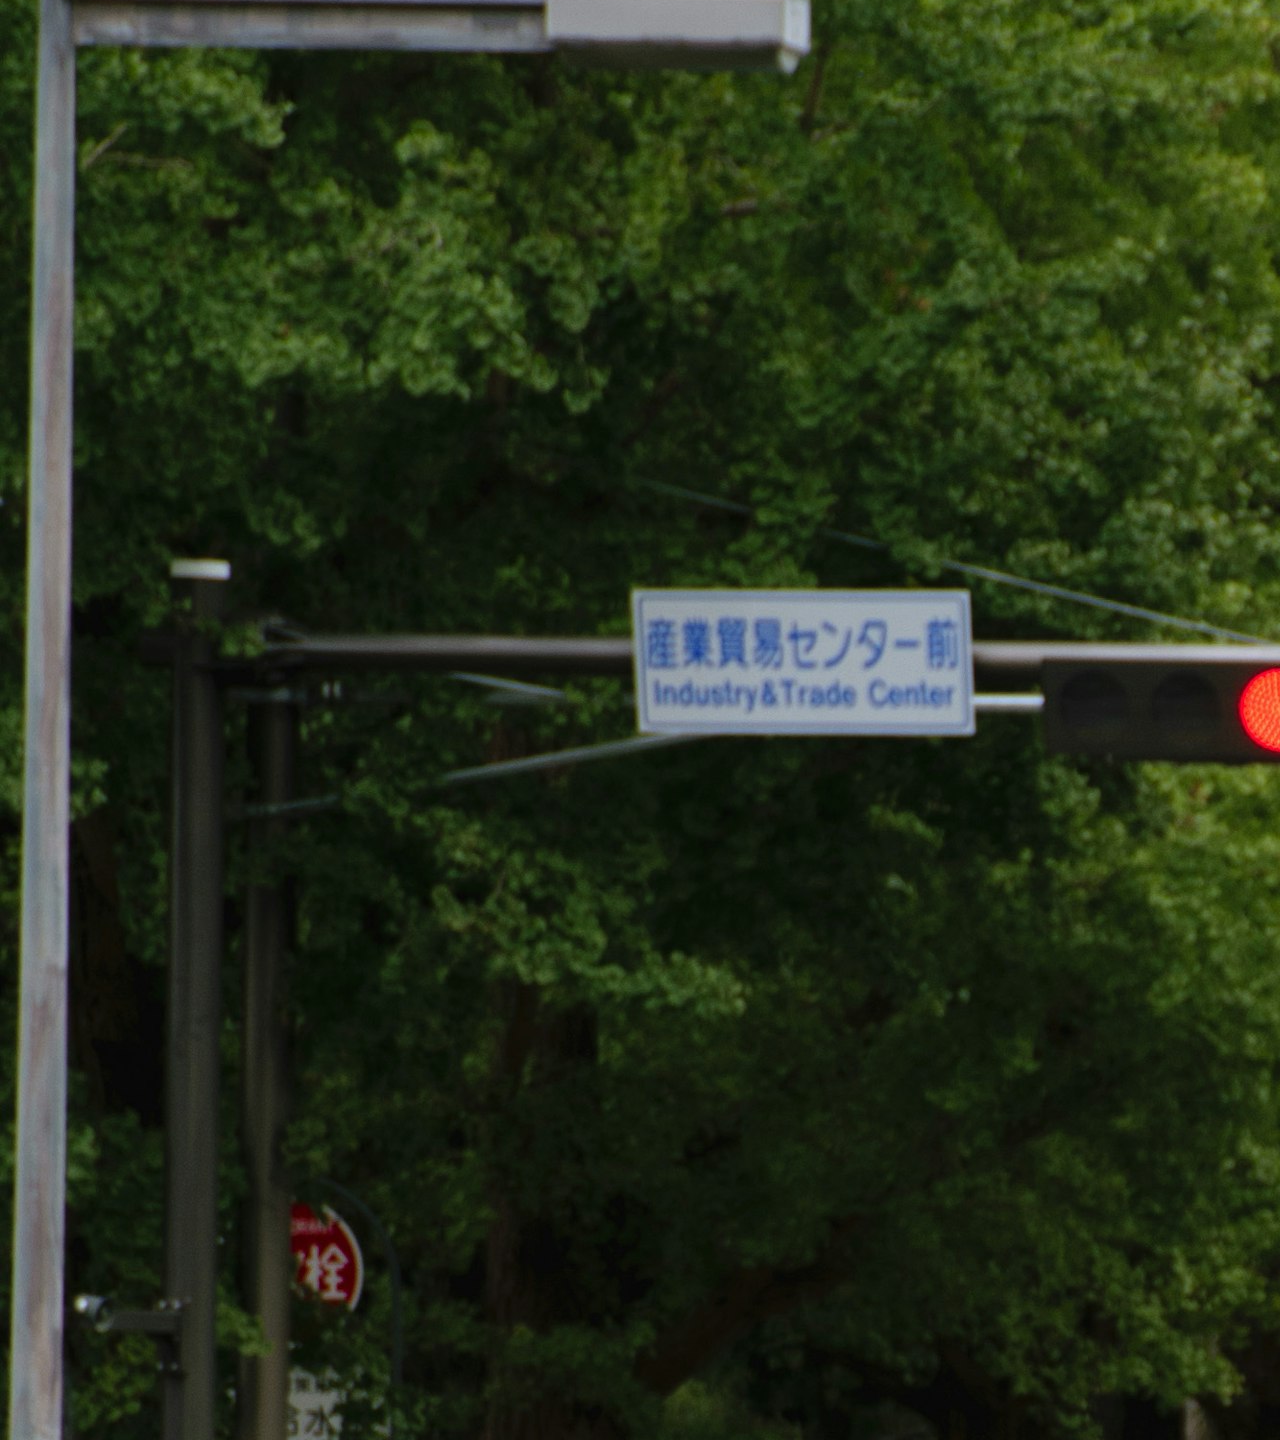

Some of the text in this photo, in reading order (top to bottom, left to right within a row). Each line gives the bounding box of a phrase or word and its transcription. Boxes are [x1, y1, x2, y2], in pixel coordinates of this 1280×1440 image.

[647, 617, 958, 670] 産業貿易センター前
[654, 678, 954, 713] Industry&Trade Center
